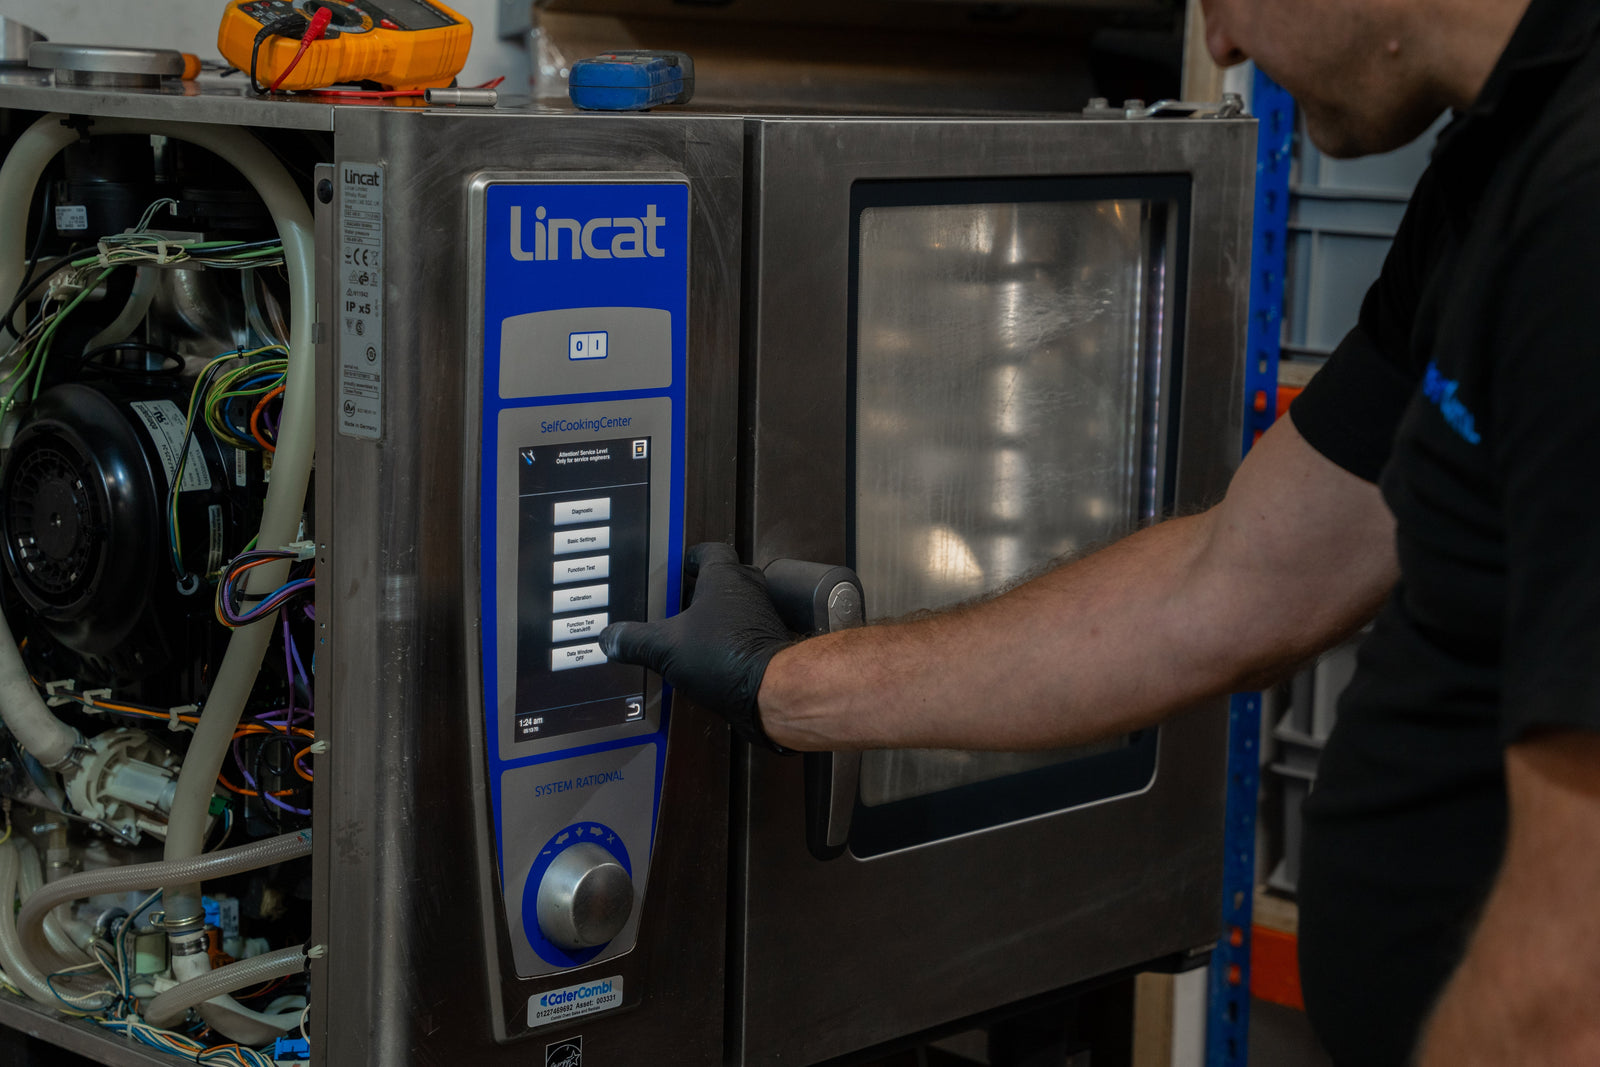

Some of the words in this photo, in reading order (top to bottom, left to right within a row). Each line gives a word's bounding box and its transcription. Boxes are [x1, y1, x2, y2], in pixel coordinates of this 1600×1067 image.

[510, 204, 666, 261] Lincat
[346, 301, 356, 312] IP
[358, 303, 371, 315] x5
[540, 416, 632, 434] SelfCookingCenter
[596, 447, 608, 455] Level
[589, 454, 610, 462] engineers
[567, 537, 579, 545] Basic
[579, 535, 597, 544] Settings
[567, 565, 586, 574] Function
[569, 594, 592, 602] Calibration
[566, 620, 585, 629] Function
[577, 648, 593, 656] Window
[519, 717, 532, 727] 1:24
[533, 717, 543, 725] am
[535, 779, 573, 797] SYSTEM
[576, 770, 625, 789] RATIONAL
[548, 980, 612, 1006] CaterCombi
[575, 1000, 594, 1010] Asset:
